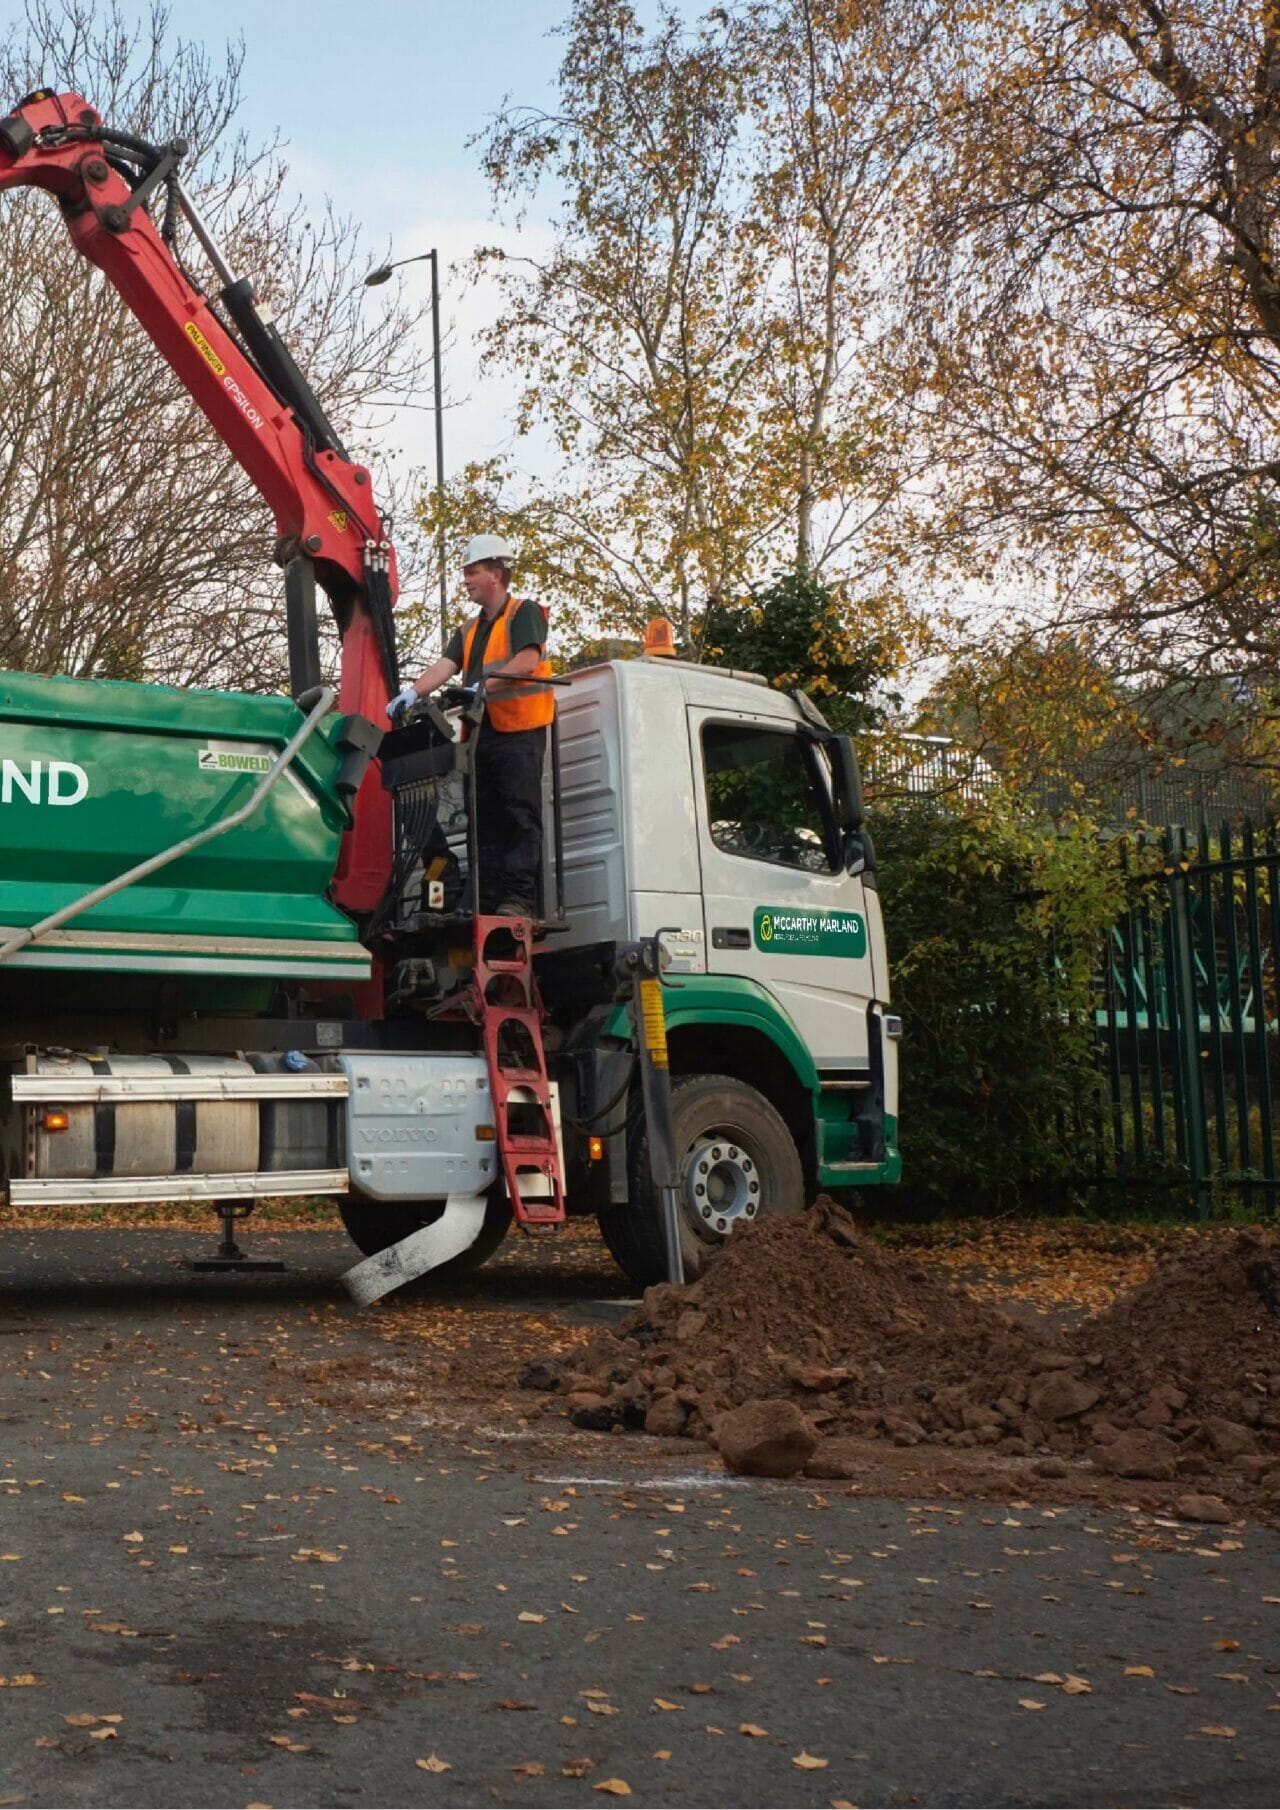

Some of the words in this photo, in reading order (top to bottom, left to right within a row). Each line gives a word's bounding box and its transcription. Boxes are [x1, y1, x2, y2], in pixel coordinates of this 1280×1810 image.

[187, 325, 223, 373] PALFINGER
[223, 376, 264, 430] EPSILON
[218, 754, 269, 771] BOWELD
[773, 916, 818, 932] MCCARTHY
[819, 918, 859, 934] MARLAND
[360, 1128, 440, 1143] VOLVO
